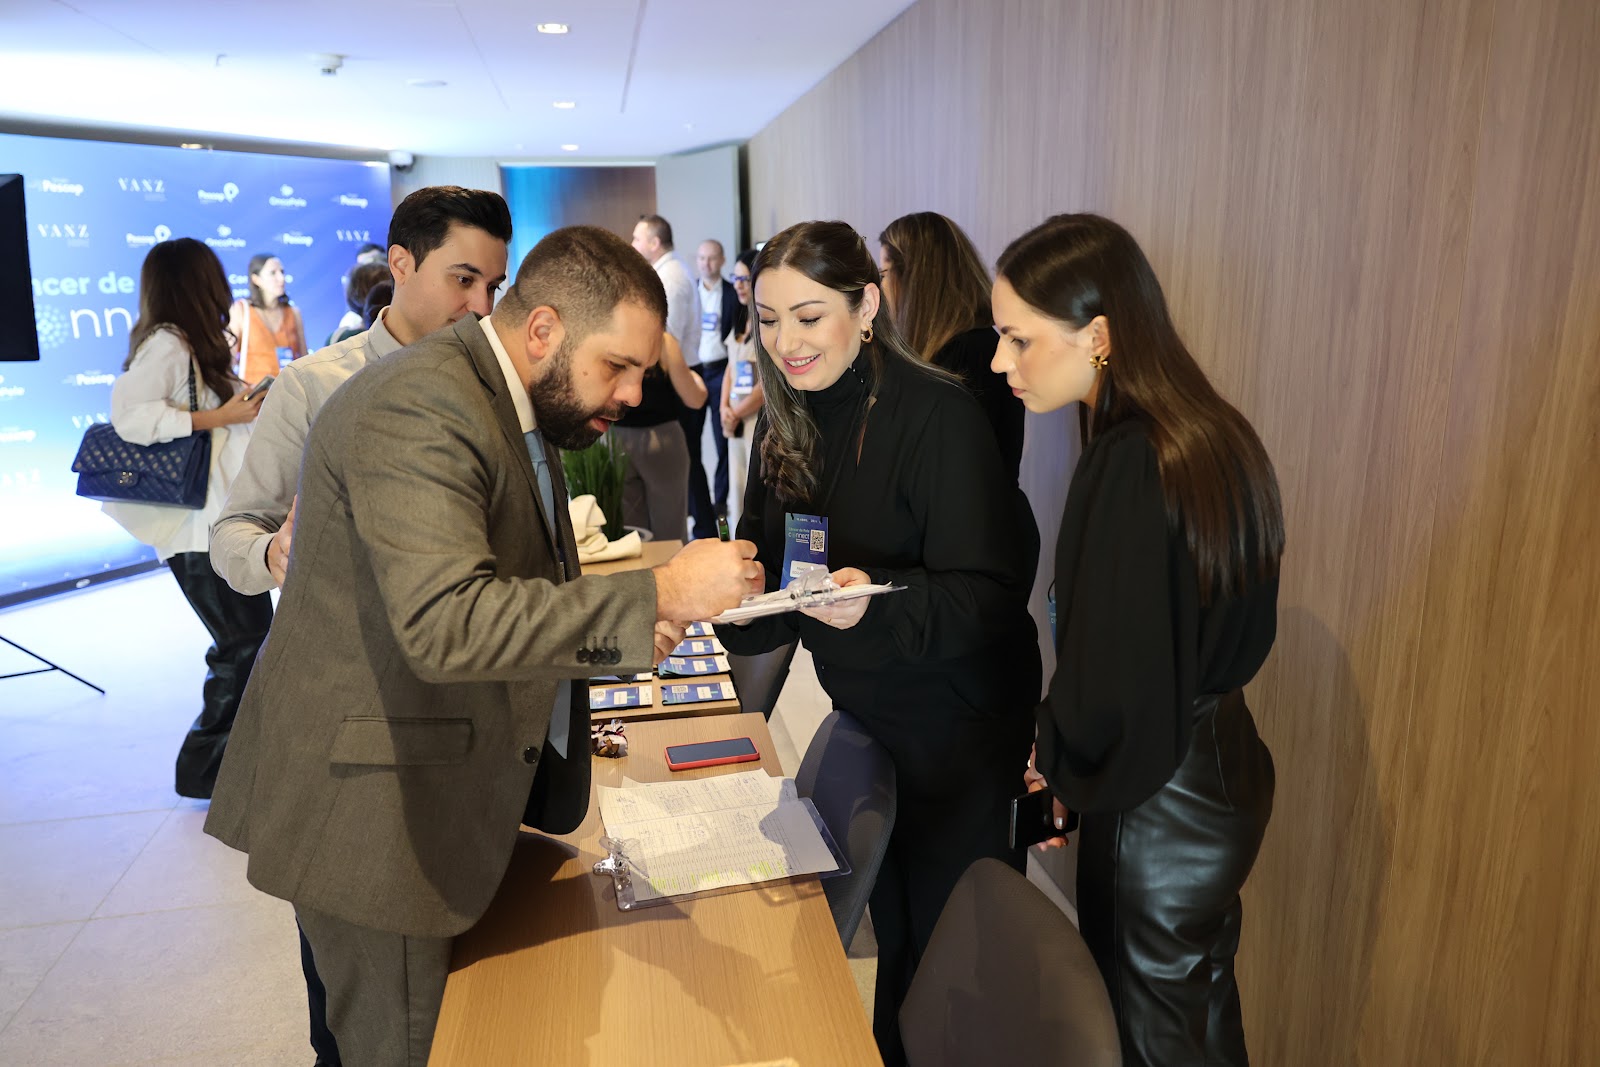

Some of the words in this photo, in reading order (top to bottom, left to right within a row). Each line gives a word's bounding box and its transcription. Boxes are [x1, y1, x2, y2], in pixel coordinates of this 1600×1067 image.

[118, 177, 165, 193] VANZ
[38, 223, 89, 238] VANZ
[32, 277, 91, 296] ncer
[98, 271, 135, 294] de
